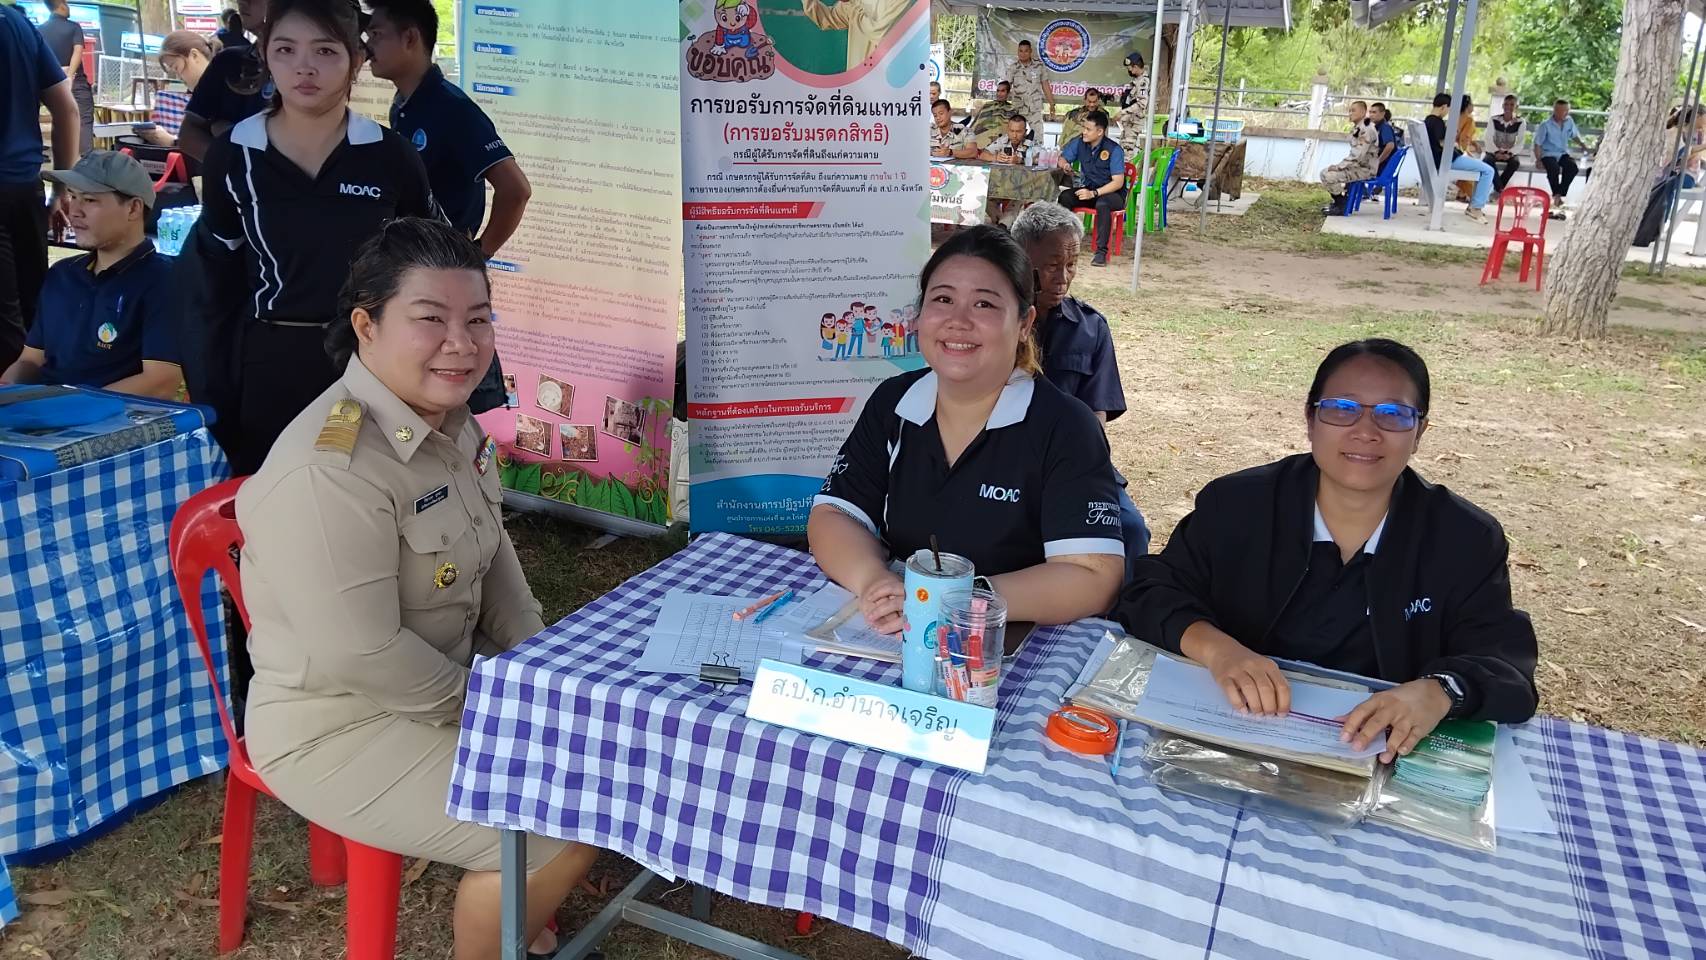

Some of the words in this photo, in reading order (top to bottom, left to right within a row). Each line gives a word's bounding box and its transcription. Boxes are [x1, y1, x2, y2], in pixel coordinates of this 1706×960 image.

[690, 47, 771, 82] ขอบคุณ
[690, 90, 922, 117] การขอรับการจัดที่ดินแทนที่
[723, 122, 889, 145] (การขอรับมรดกสิทธิ)
[733, 148, 879, 162] กรณีผู้ได้รับการจัดที่ดินถึงแก่ความตาย
[707, 172, 723, 181] กรณี
[340, 183, 381, 198] MOAC
[696, 403, 831, 418] หลักฐานที่ต้องเตรียมในการขอรับบริการ
[979, 483, 1021, 503] MOAC
[771, 677, 959, 741] ส.ป.ก.อำนาจเจริญ
